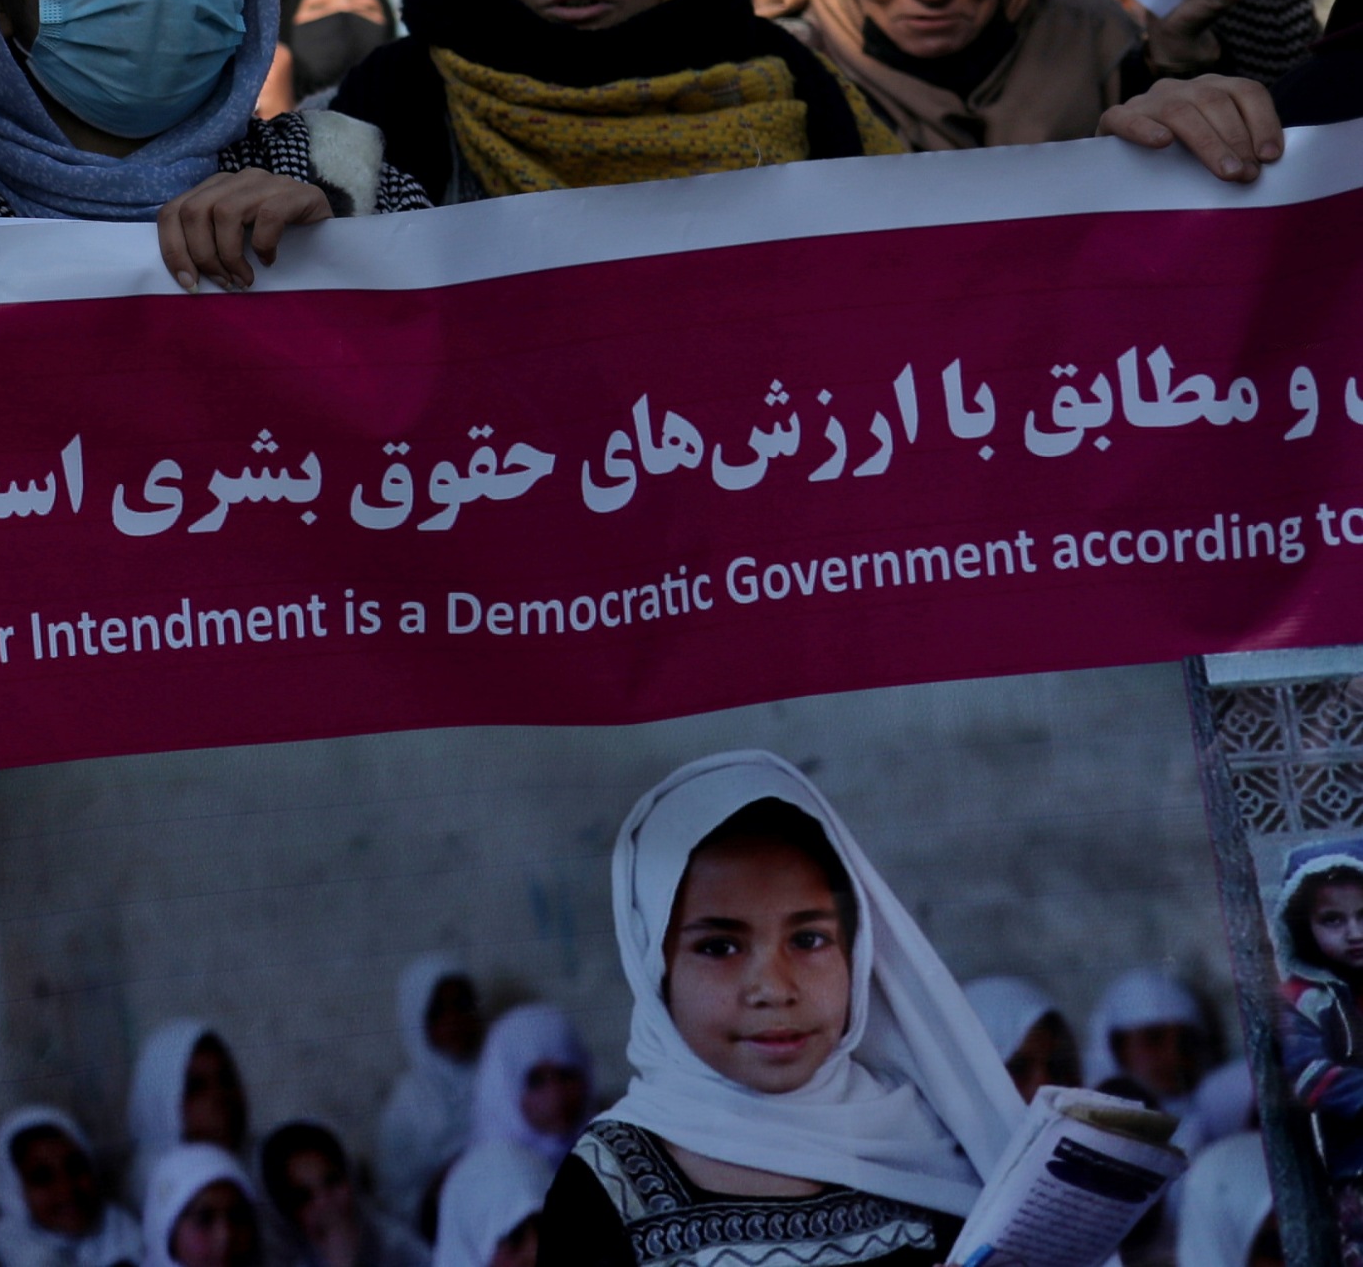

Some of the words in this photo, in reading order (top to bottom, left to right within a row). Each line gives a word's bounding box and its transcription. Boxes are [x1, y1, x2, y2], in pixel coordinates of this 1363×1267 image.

[941, 358, 997, 460] با
[1024, 344, 1260, 458] مطابق
[1283, 366, 1319, 441] و
[111, 429, 323, 537] بشری
[350, 425, 556, 531] حقوق
[30, 593, 327, 659] Intendment
[345, 589, 382, 633] is
[400, 600, 426, 633] a
[447, 565, 712, 635] Democratic
[726, 529, 1037, 605] Government
[1054, 514, 1306, 569] according
[1316, 503, 1363, 546] to
